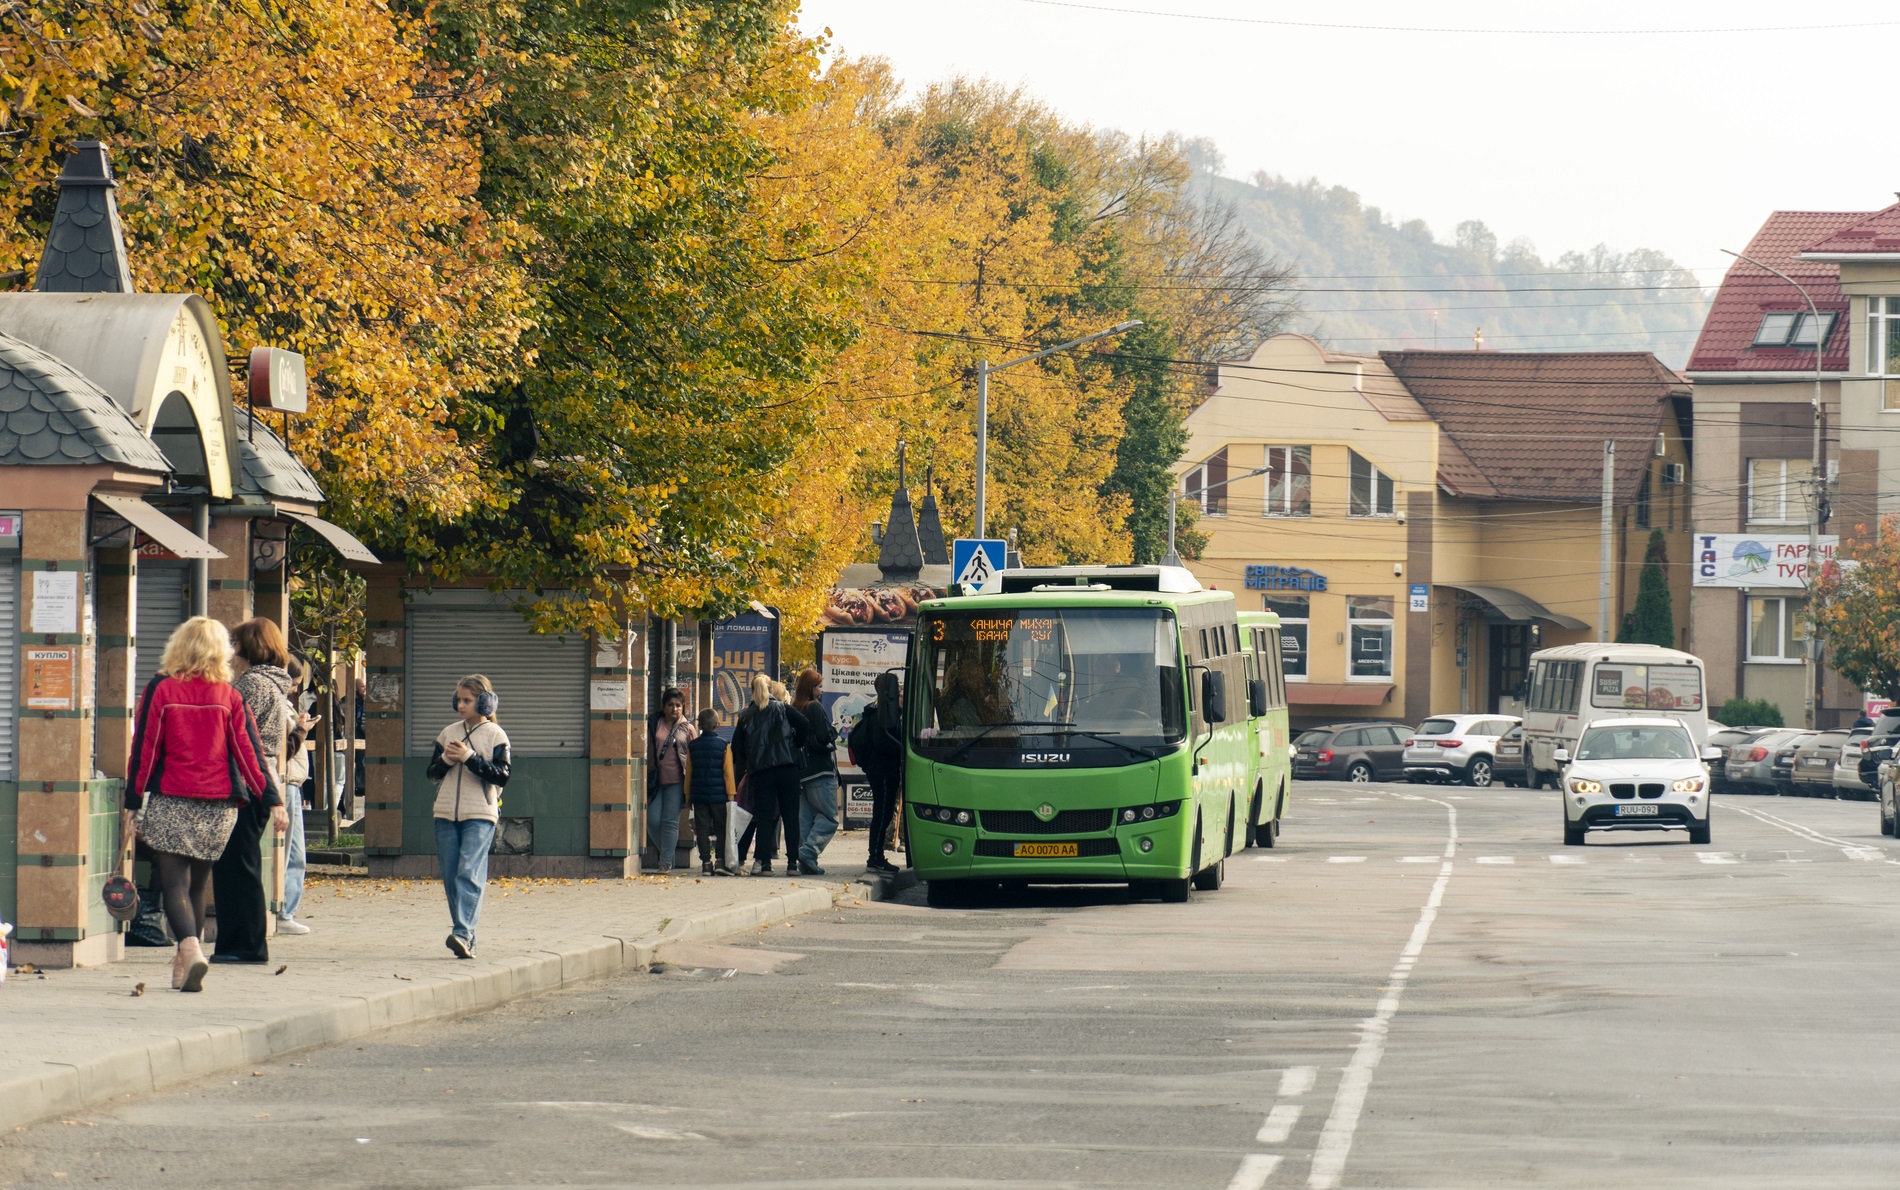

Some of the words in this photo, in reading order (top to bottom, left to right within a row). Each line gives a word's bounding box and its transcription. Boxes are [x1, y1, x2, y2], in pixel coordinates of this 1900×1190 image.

[1245, 565, 1278, 576] СВІТ
[1244, 576, 1327, 592] МАТРАЦІВ
[1413, 599, 1425, 608] 32
[726, 625, 768, 633] ЛОМБАРД
[933, 620, 945, 641] 3
[831, 655, 853, 665] Курс:
[831, 668, 861, 677] Цікаве
[1021, 753, 1071, 763] ISUZU
[1620, 804, 1657, 815] RUU-092
[1036, 845, 1059, 854] 0070
